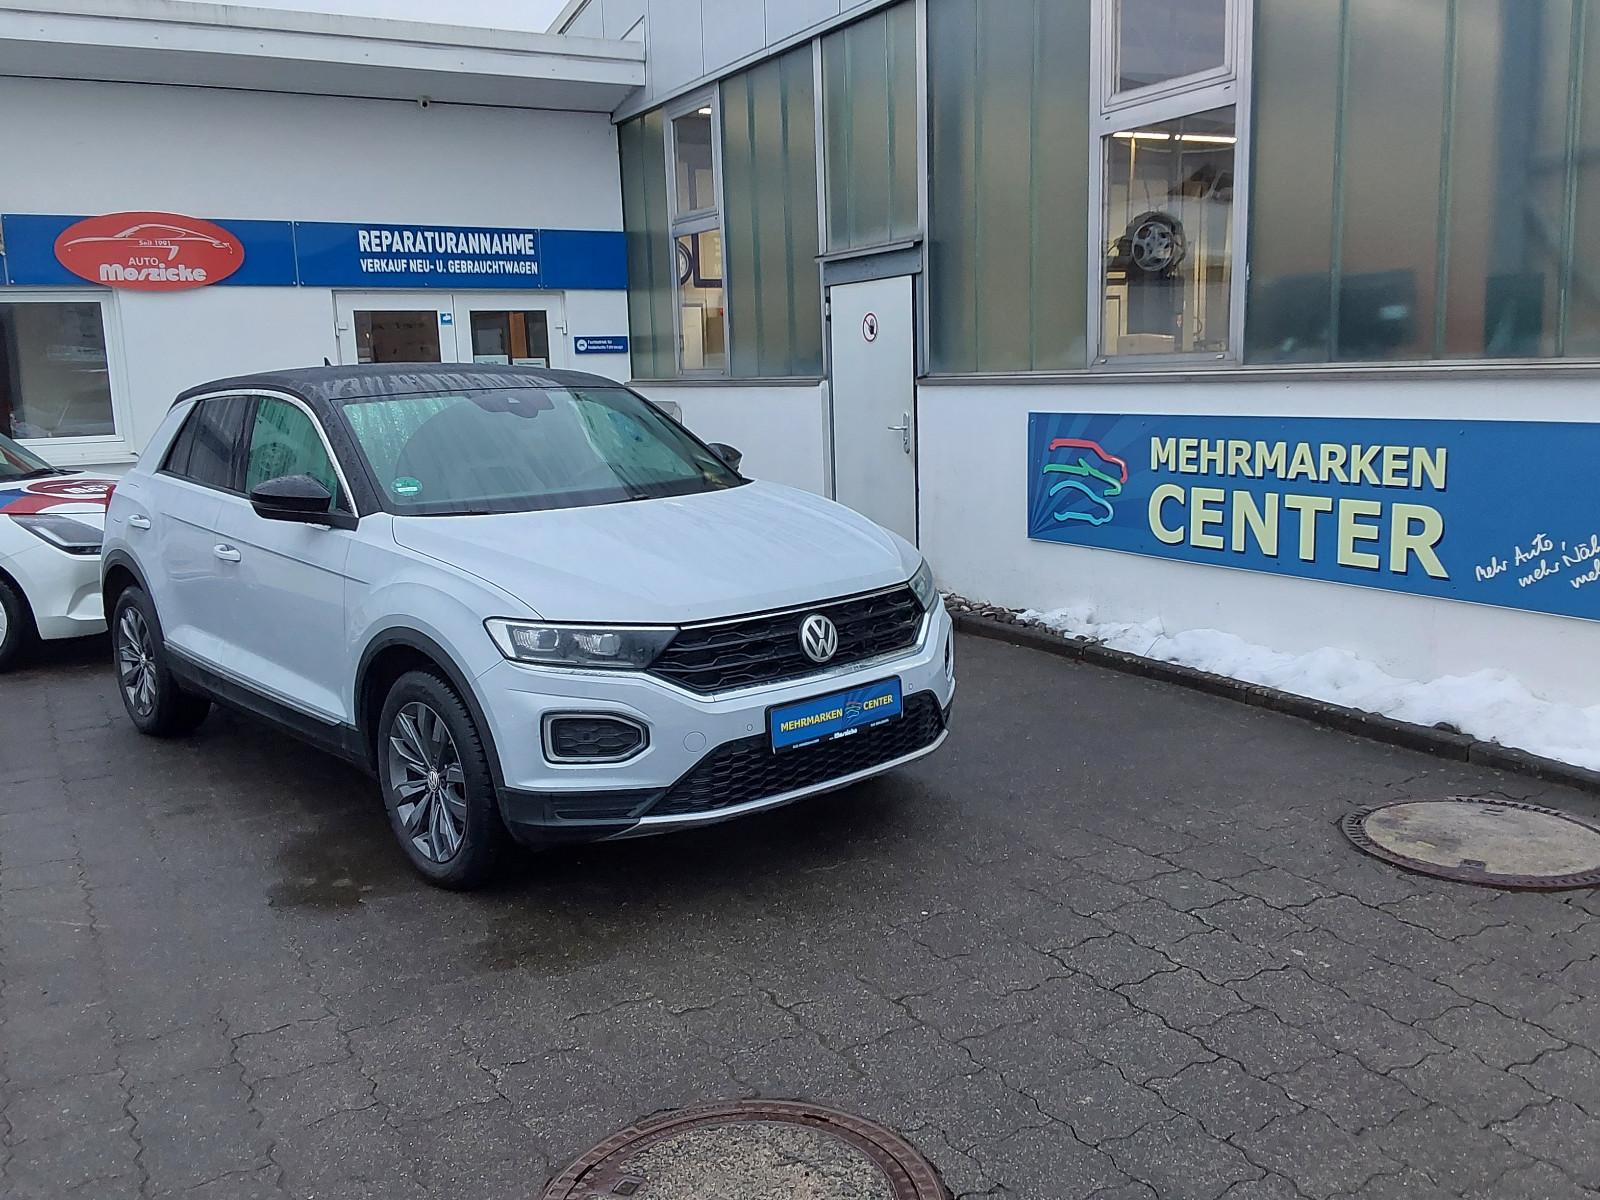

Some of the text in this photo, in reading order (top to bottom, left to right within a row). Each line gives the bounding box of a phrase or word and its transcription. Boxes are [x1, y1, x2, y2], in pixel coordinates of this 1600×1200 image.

[358, 229, 535, 255] REPARATURANNAHME
[128, 257, 159, 266] AUTO
[360, 258, 538, 275] VERKAUF NEU- U. GEBRAUCHTWAGEN
[1150, 436, 1448, 490] MEHRMARKEN
[1148, 483, 1450, 579] CENTER
[780, 694, 893, 732] MEHRMARKEN CENTER
